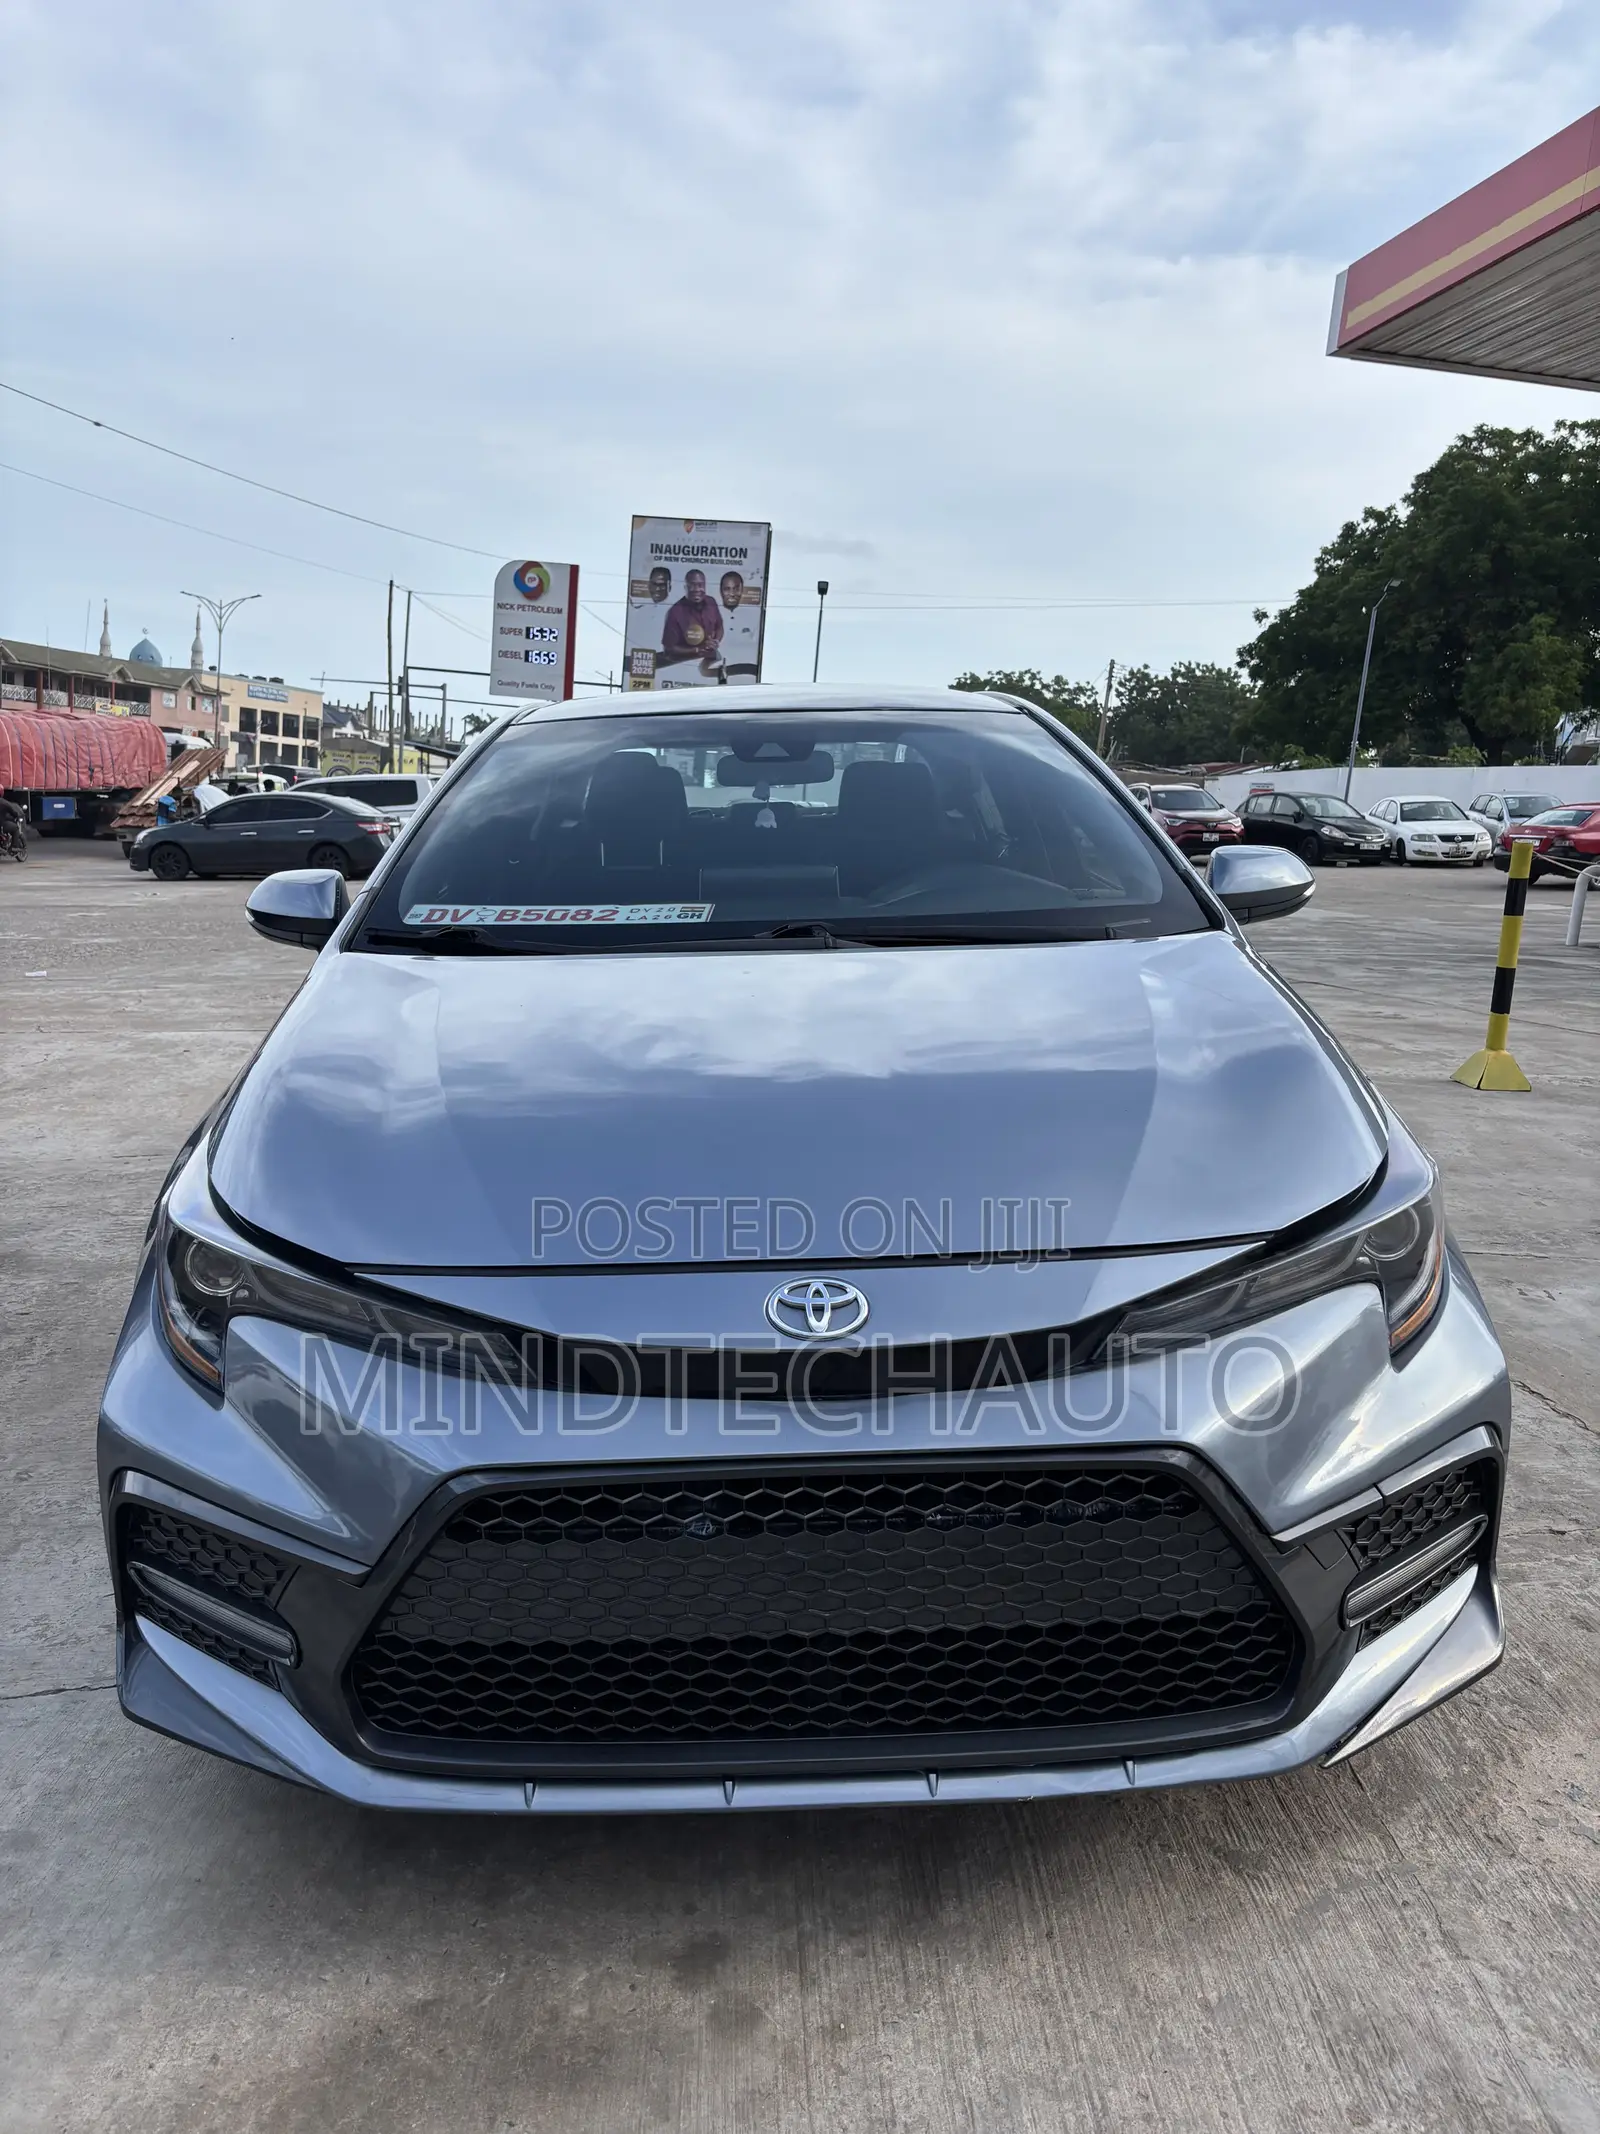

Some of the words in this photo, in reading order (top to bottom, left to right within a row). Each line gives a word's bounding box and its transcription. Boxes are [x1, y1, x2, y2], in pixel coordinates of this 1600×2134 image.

[650, 543, 748, 559] INAUGURATION
[710, 558, 743, 566] BUILDING
[497, 602, 515, 611] NICK
[517, 604, 563, 614] PETROLEUM
[500, 626, 523, 636] SUPER
[529, 627, 558, 642] 1532
[498, 650, 523, 660] DIESEL
[528, 650, 557, 665] 1669
[633, 651, 653, 660] 14TH
[632, 659, 653, 668] JUNE
[497, 679, 520, 688] Quality
[521, 681, 538, 689] Fuels
[540, 682, 555, 692] Only
[632, 680, 651, 689] 2PM
[420, 908, 475, 923] DV
[494, 908, 619, 922] B5082
[677, 912, 704, 920] GH
